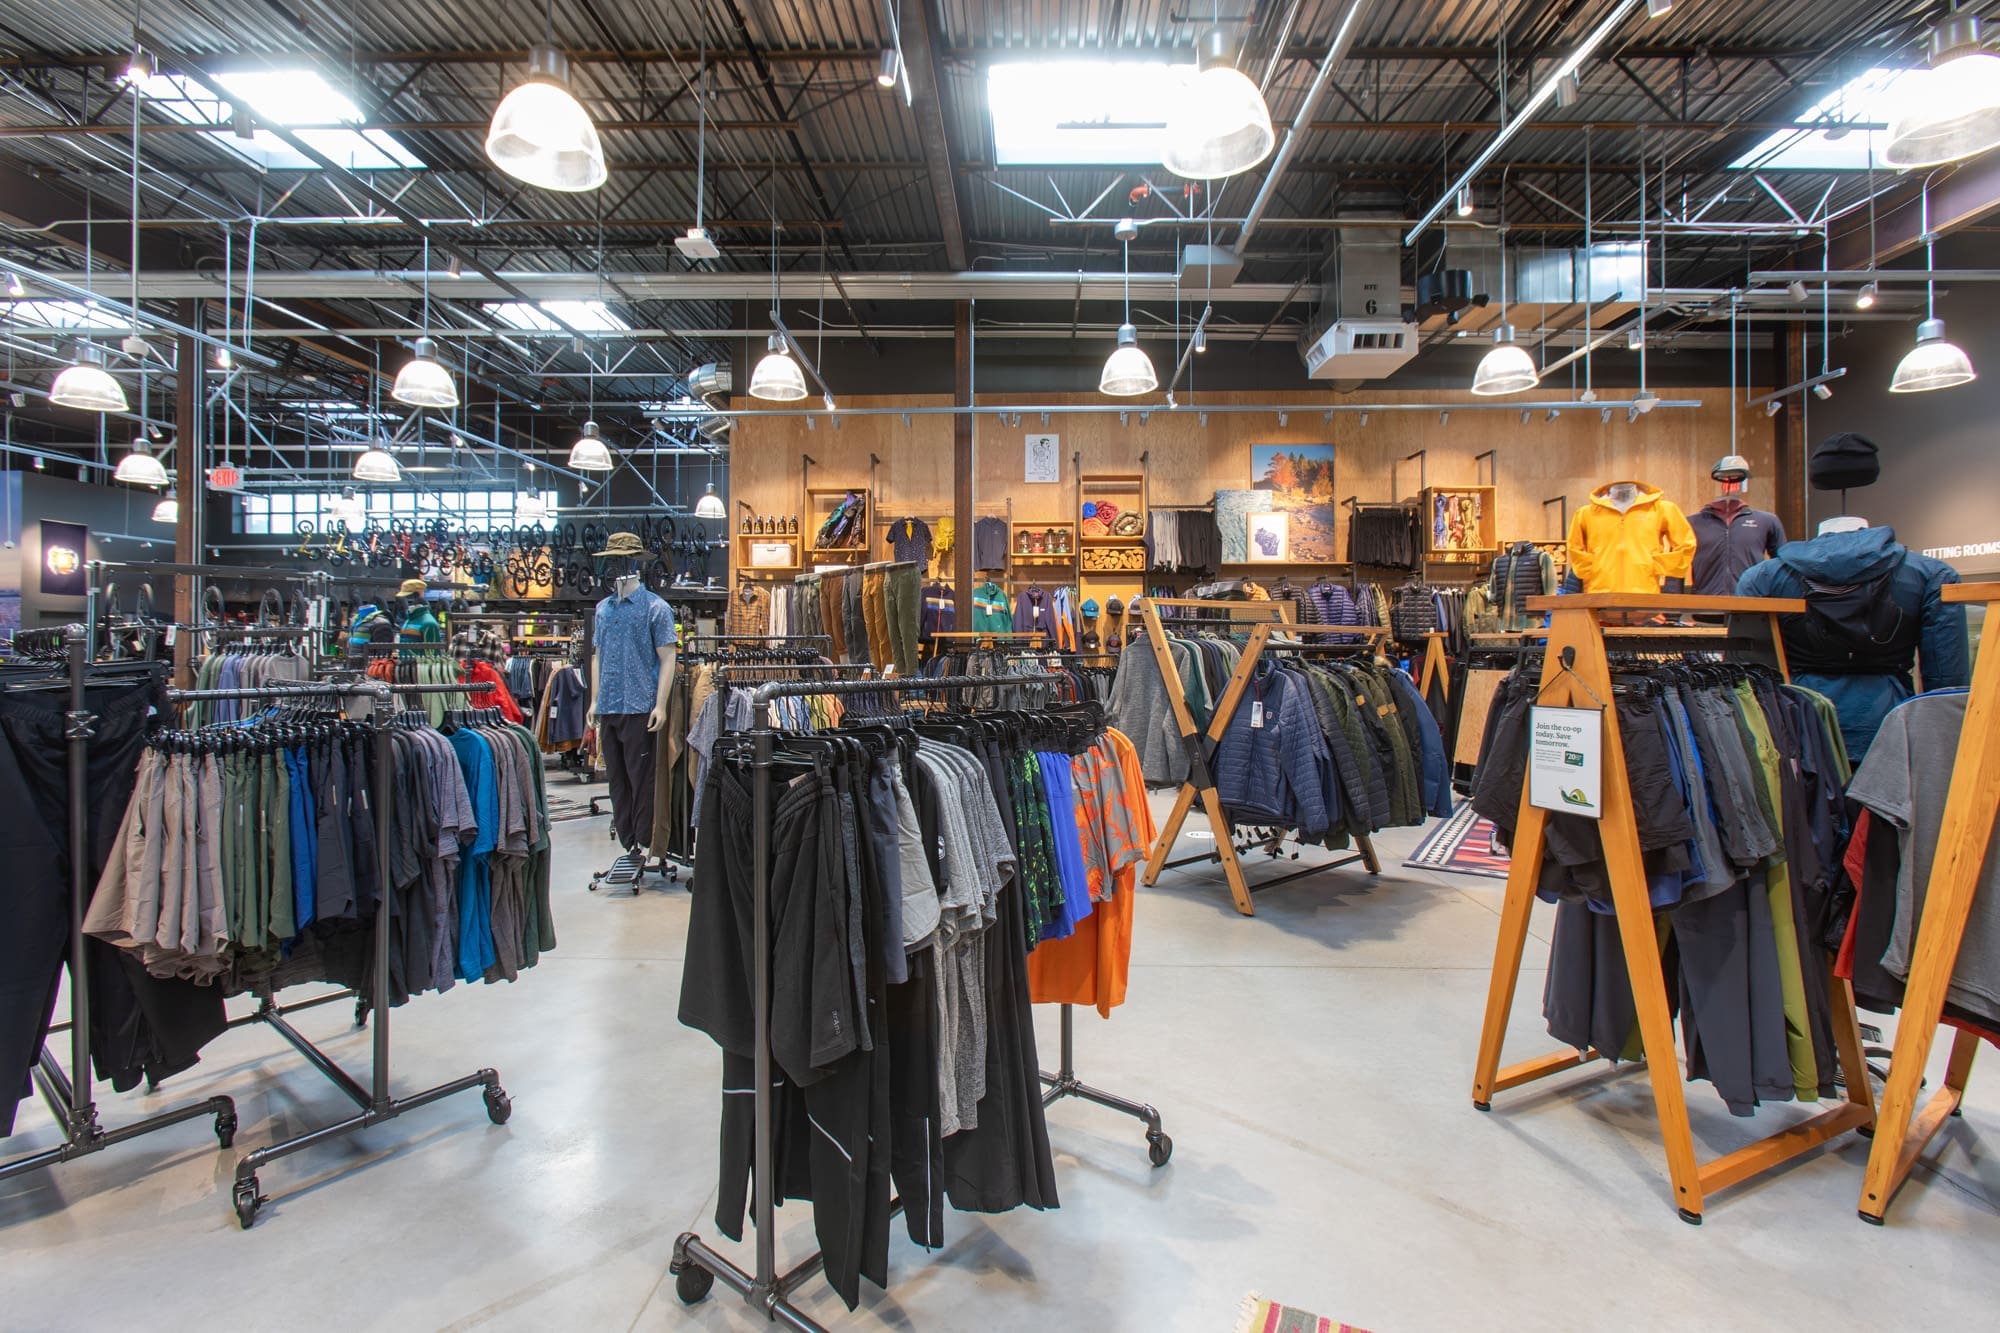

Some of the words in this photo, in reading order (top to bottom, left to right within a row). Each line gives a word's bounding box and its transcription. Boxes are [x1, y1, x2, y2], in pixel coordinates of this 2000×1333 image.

[1365, 299, 1377, 315] 6
[216, 470, 236, 487] EXIT
[1922, 545, 1961, 559] FITTING
[1963, 541, 2000, 557] ROOMS
[1536, 722, 1550, 730] Join
[1551, 723, 1561, 731] the
[1536, 731, 1555, 739] today.
[1536, 739, 1570, 748] tomorrow.
